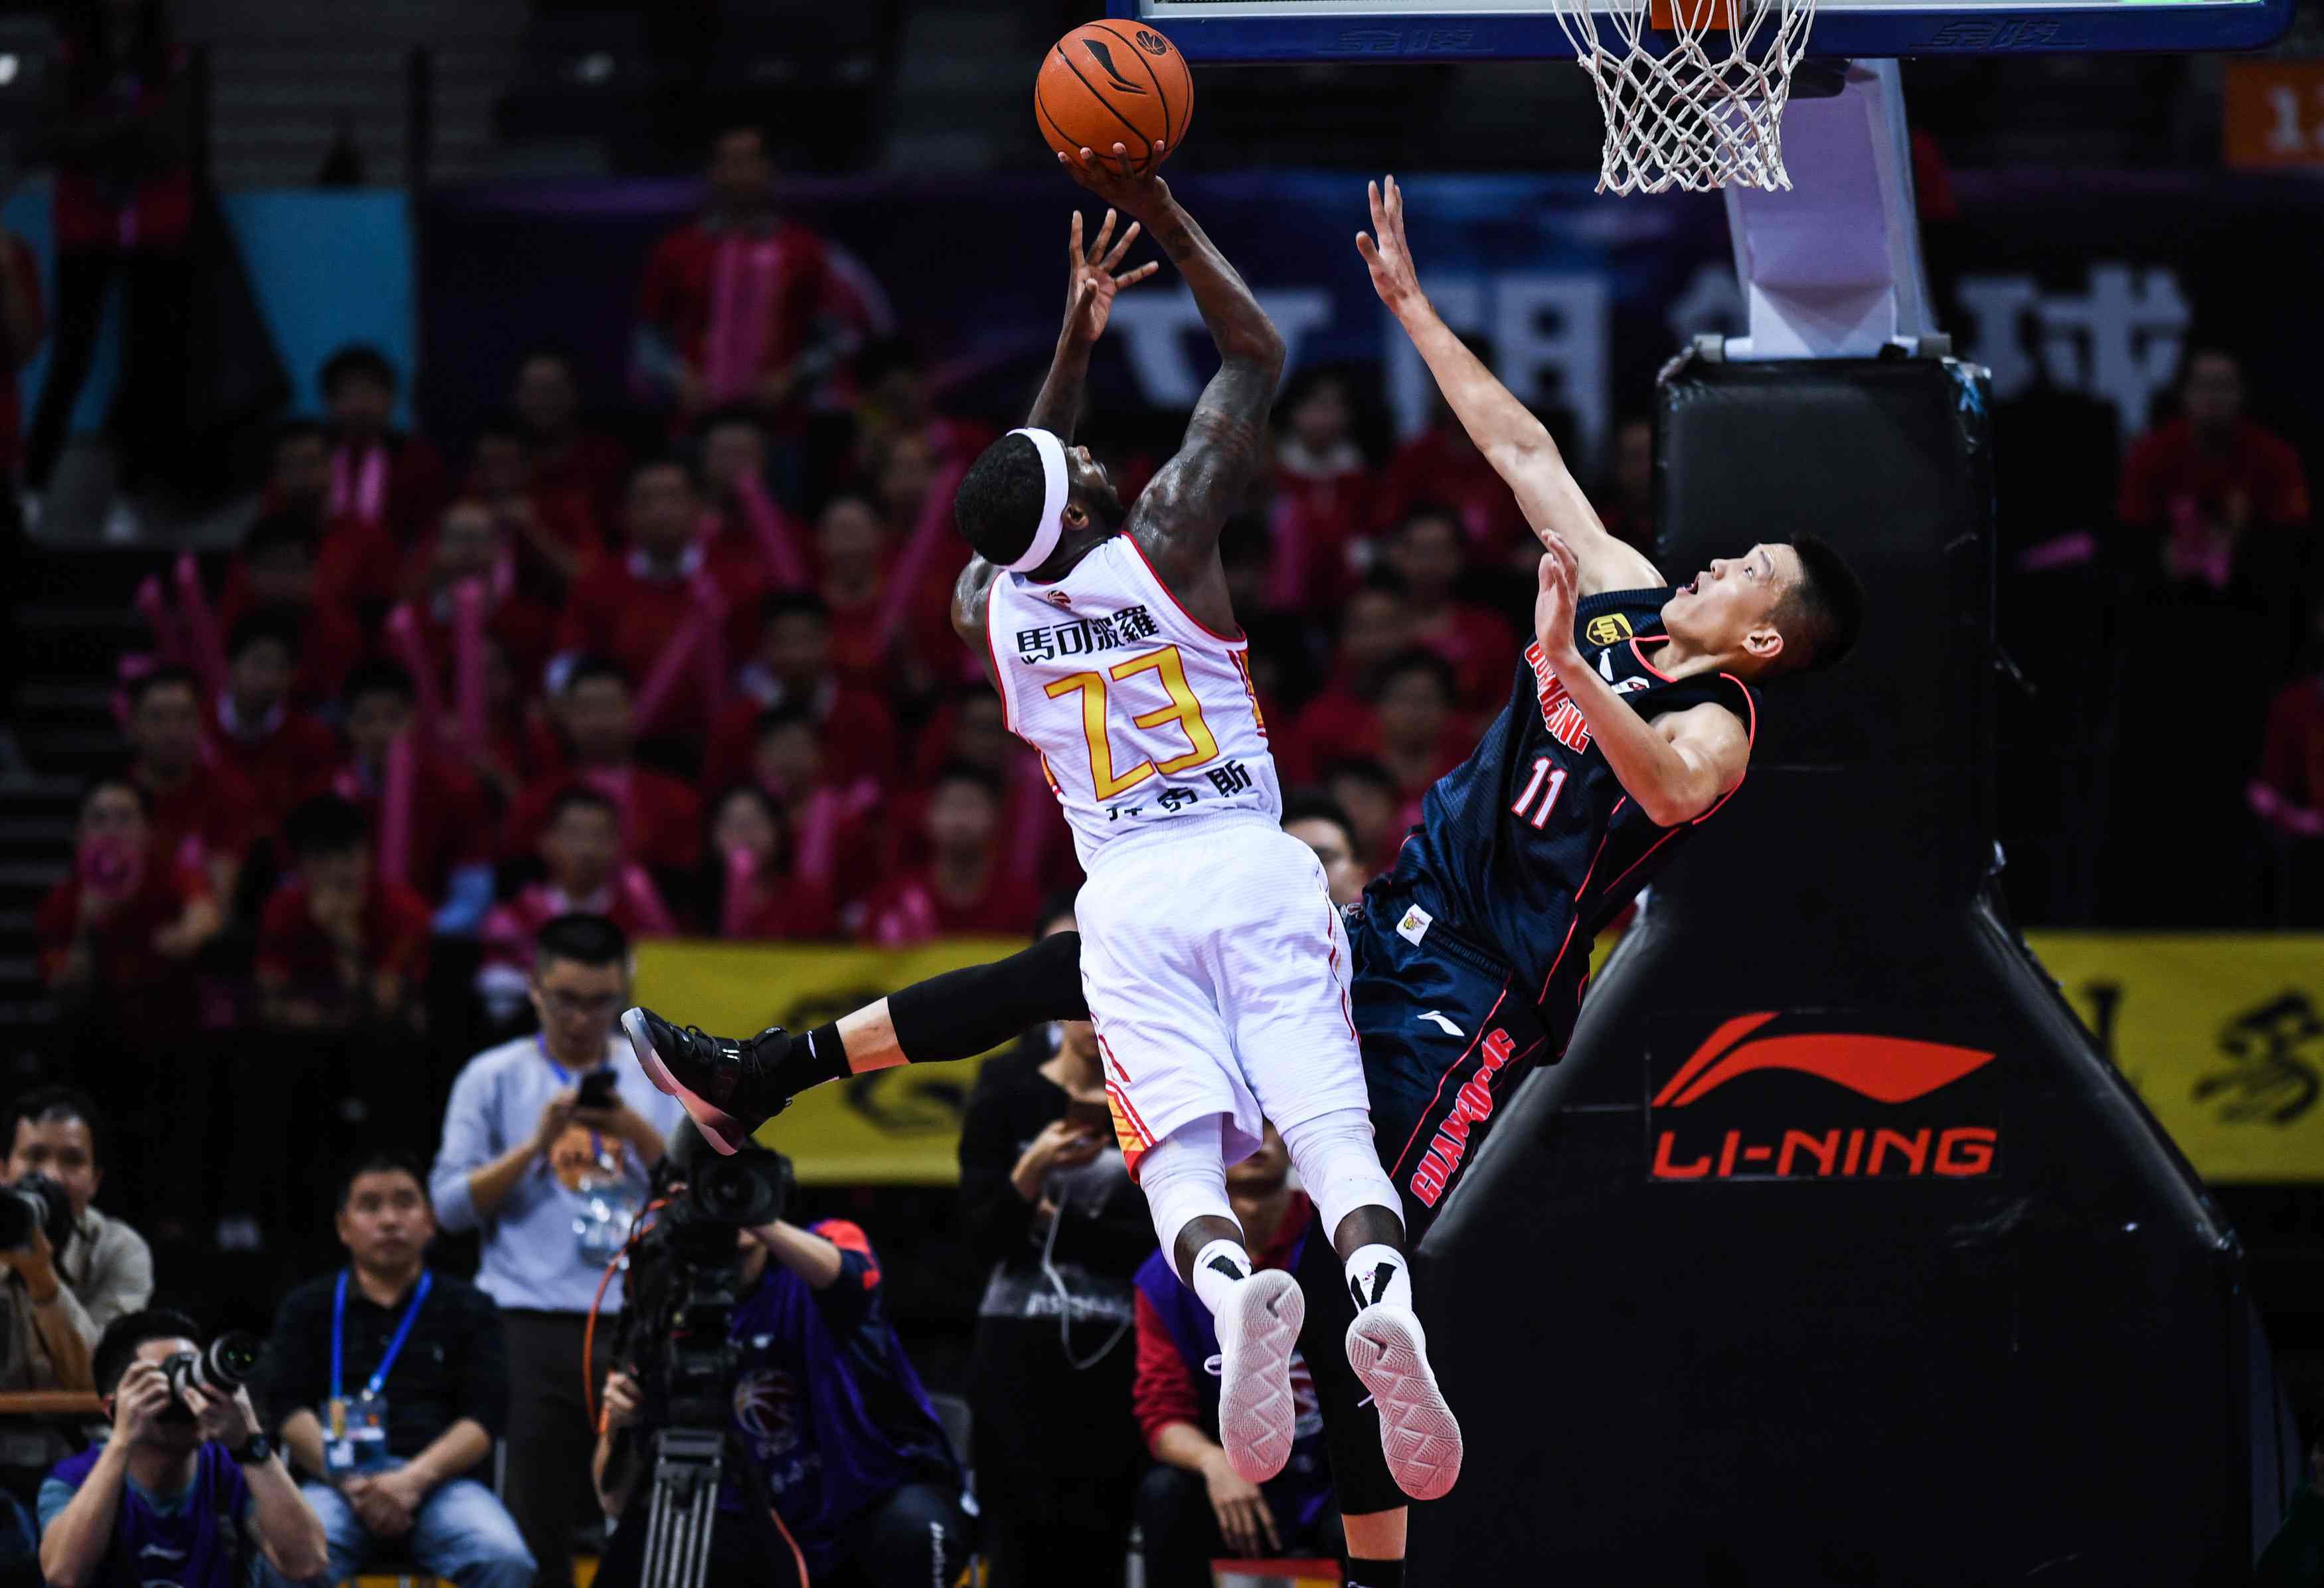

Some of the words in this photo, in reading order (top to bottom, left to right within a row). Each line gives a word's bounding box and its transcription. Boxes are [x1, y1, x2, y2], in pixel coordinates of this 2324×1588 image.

[1015, 604, 1159, 665] 馬可波羅
[1043, 644, 1220, 801] 23
[1511, 756, 1568, 830] 11
[1652, 1127, 1997, 1179] LI-NING
